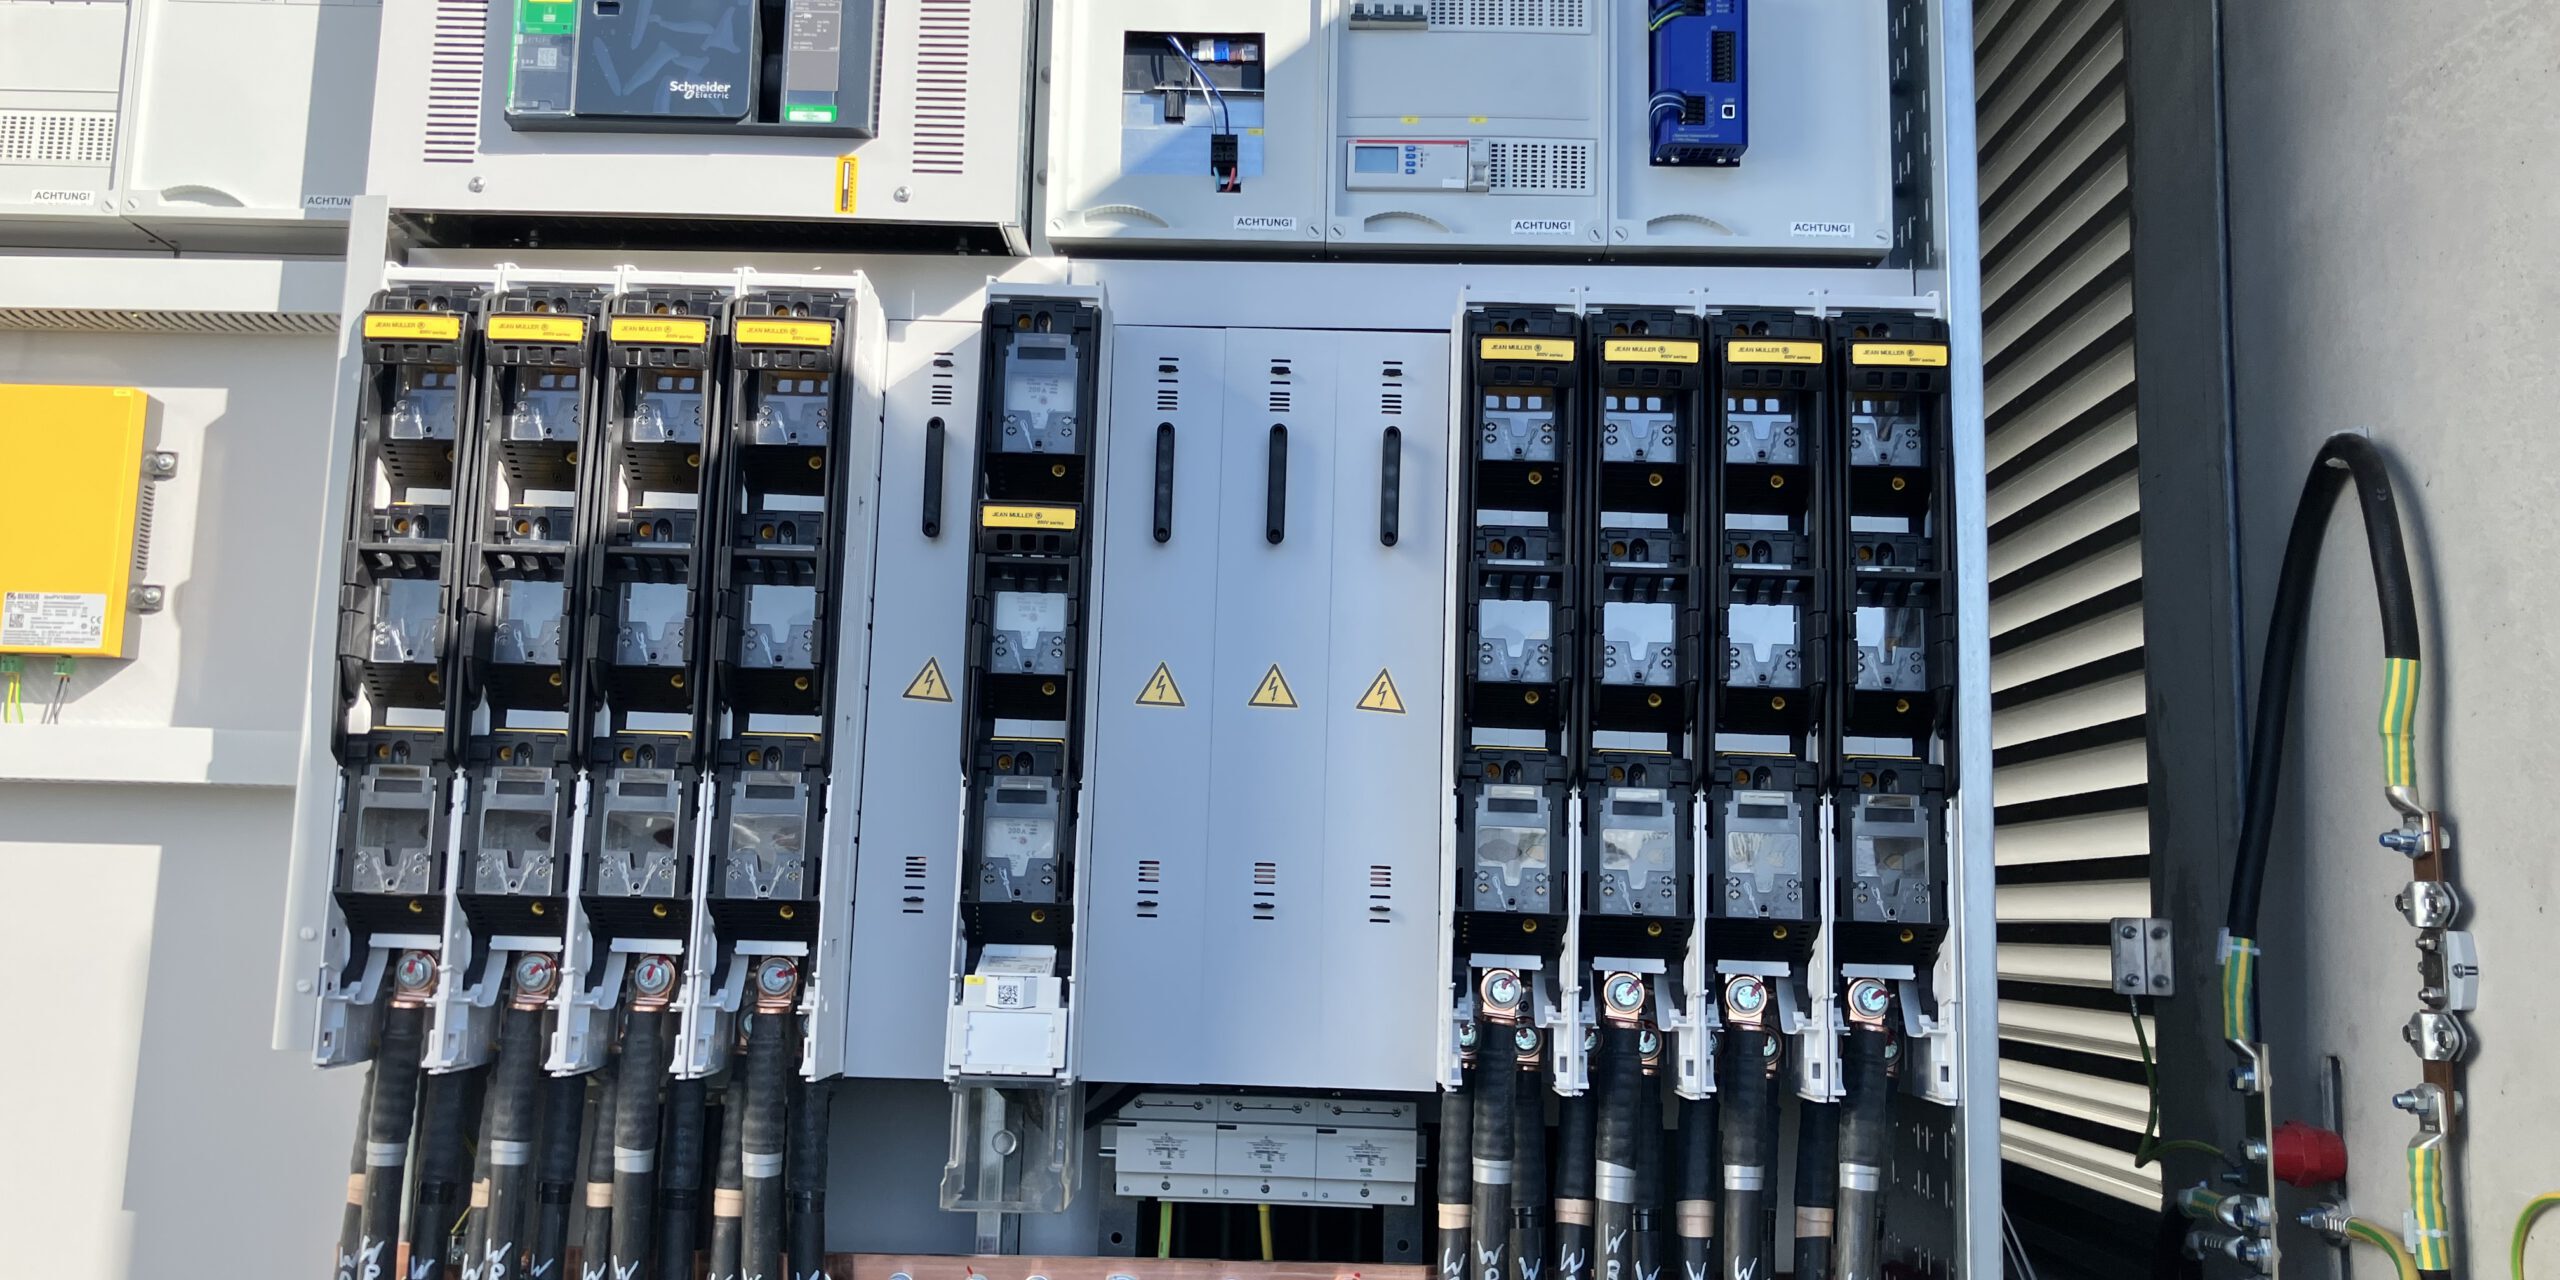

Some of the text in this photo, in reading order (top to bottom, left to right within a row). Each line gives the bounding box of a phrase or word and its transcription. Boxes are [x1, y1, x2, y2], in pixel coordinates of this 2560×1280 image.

[670, 80, 731, 92] Schneider
[34, 191, 90, 201] ACHTUNG!
[1237, 218, 1292, 227] ACHTUNG!
[1514, 221, 1571, 230] ACHTUNG!
[1794, 223, 1851, 232] ACHTUNG!
[1604, 1222, 1627, 1256] W
[486, 1238, 512, 1265] W
[1444, 1248, 1465, 1276] W
[1477, 1240, 1504, 1266] W
[1560, 1243, 1586, 1274] W
[411, 1256, 436, 1280] W
[530, 1255, 554, 1278] W
